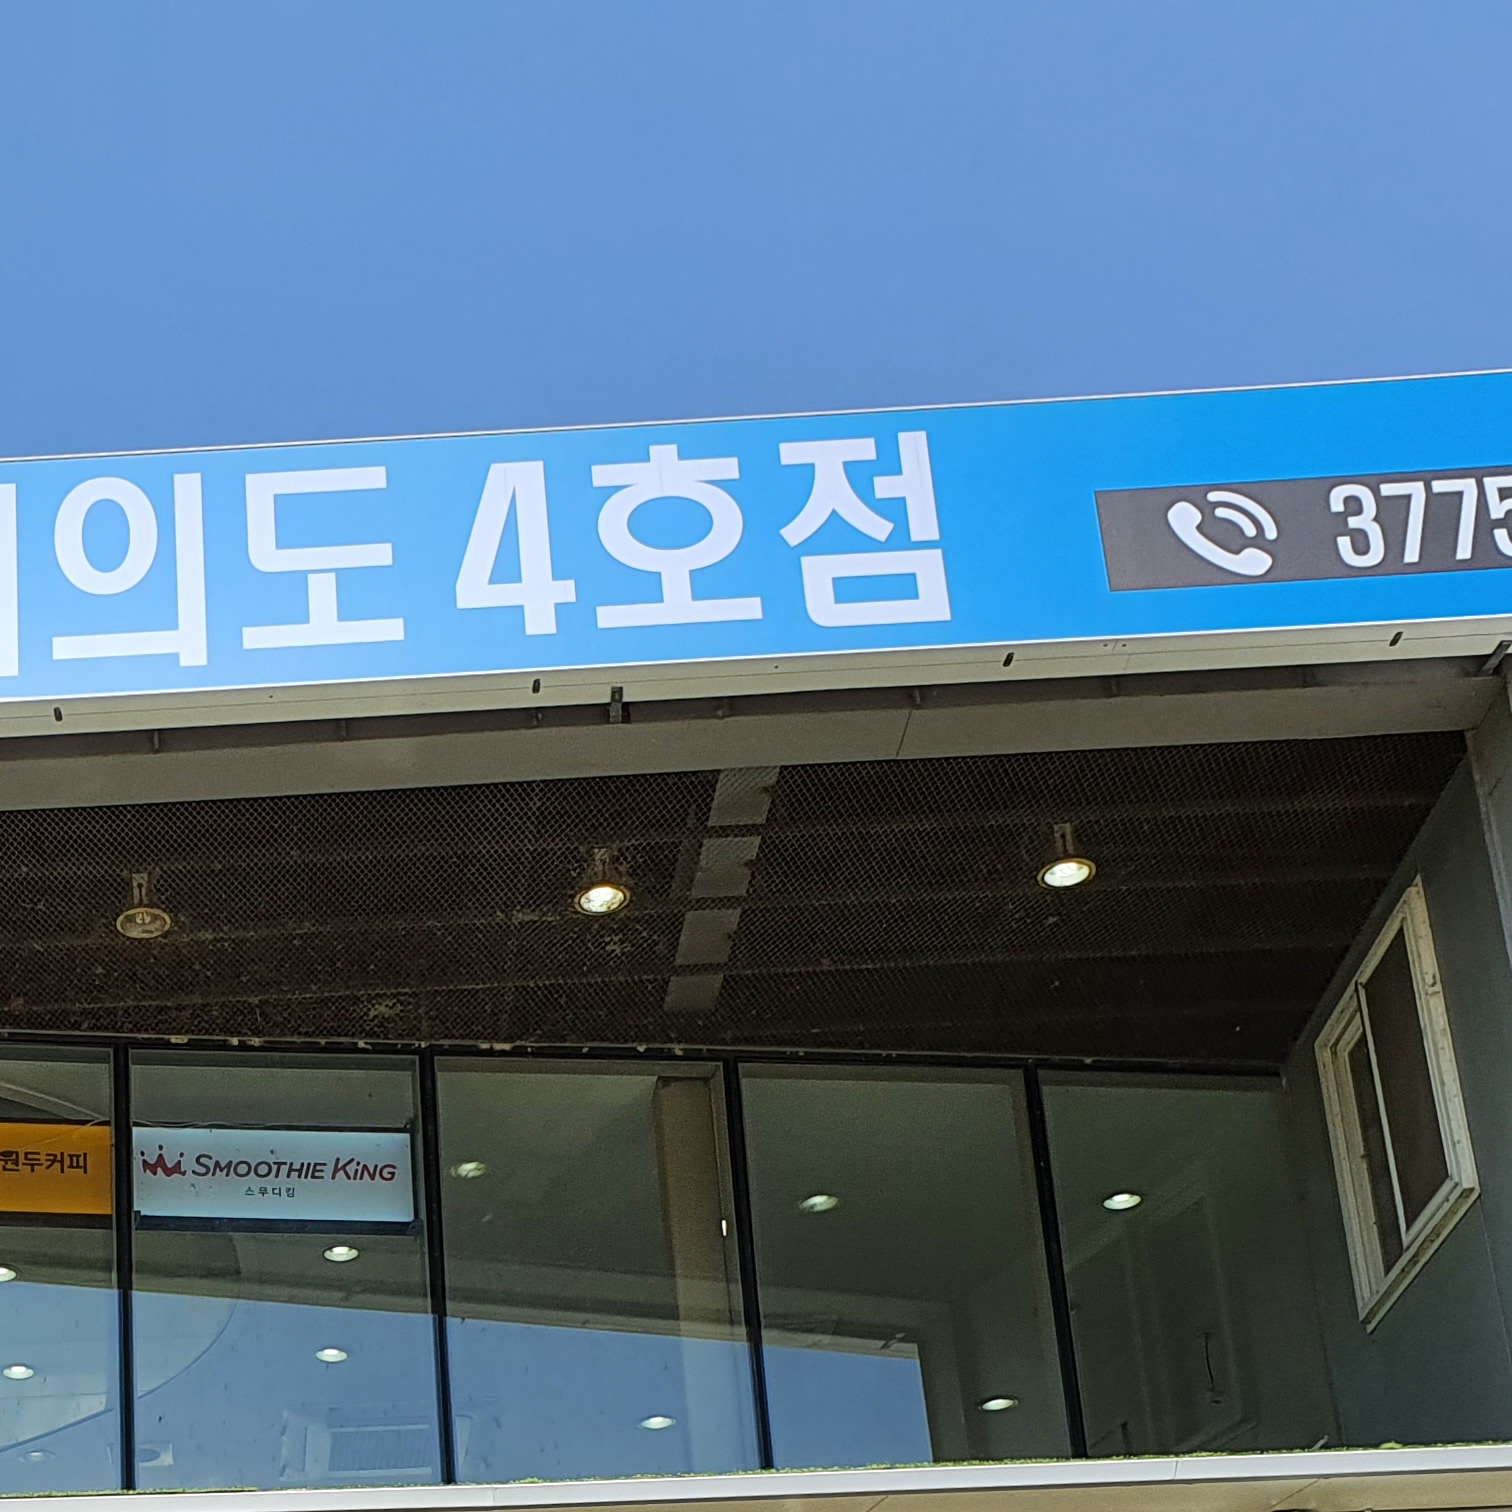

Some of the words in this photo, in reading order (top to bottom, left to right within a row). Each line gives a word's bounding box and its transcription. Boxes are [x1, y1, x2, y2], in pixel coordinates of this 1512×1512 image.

[455, 431, 952, 636] 4호점
[0, 1150, 88, 1175] 원두커피
[191, 1153, 328, 1179] SMOOTHIE
[244, 1186, 296, 1198] 스무디킹
